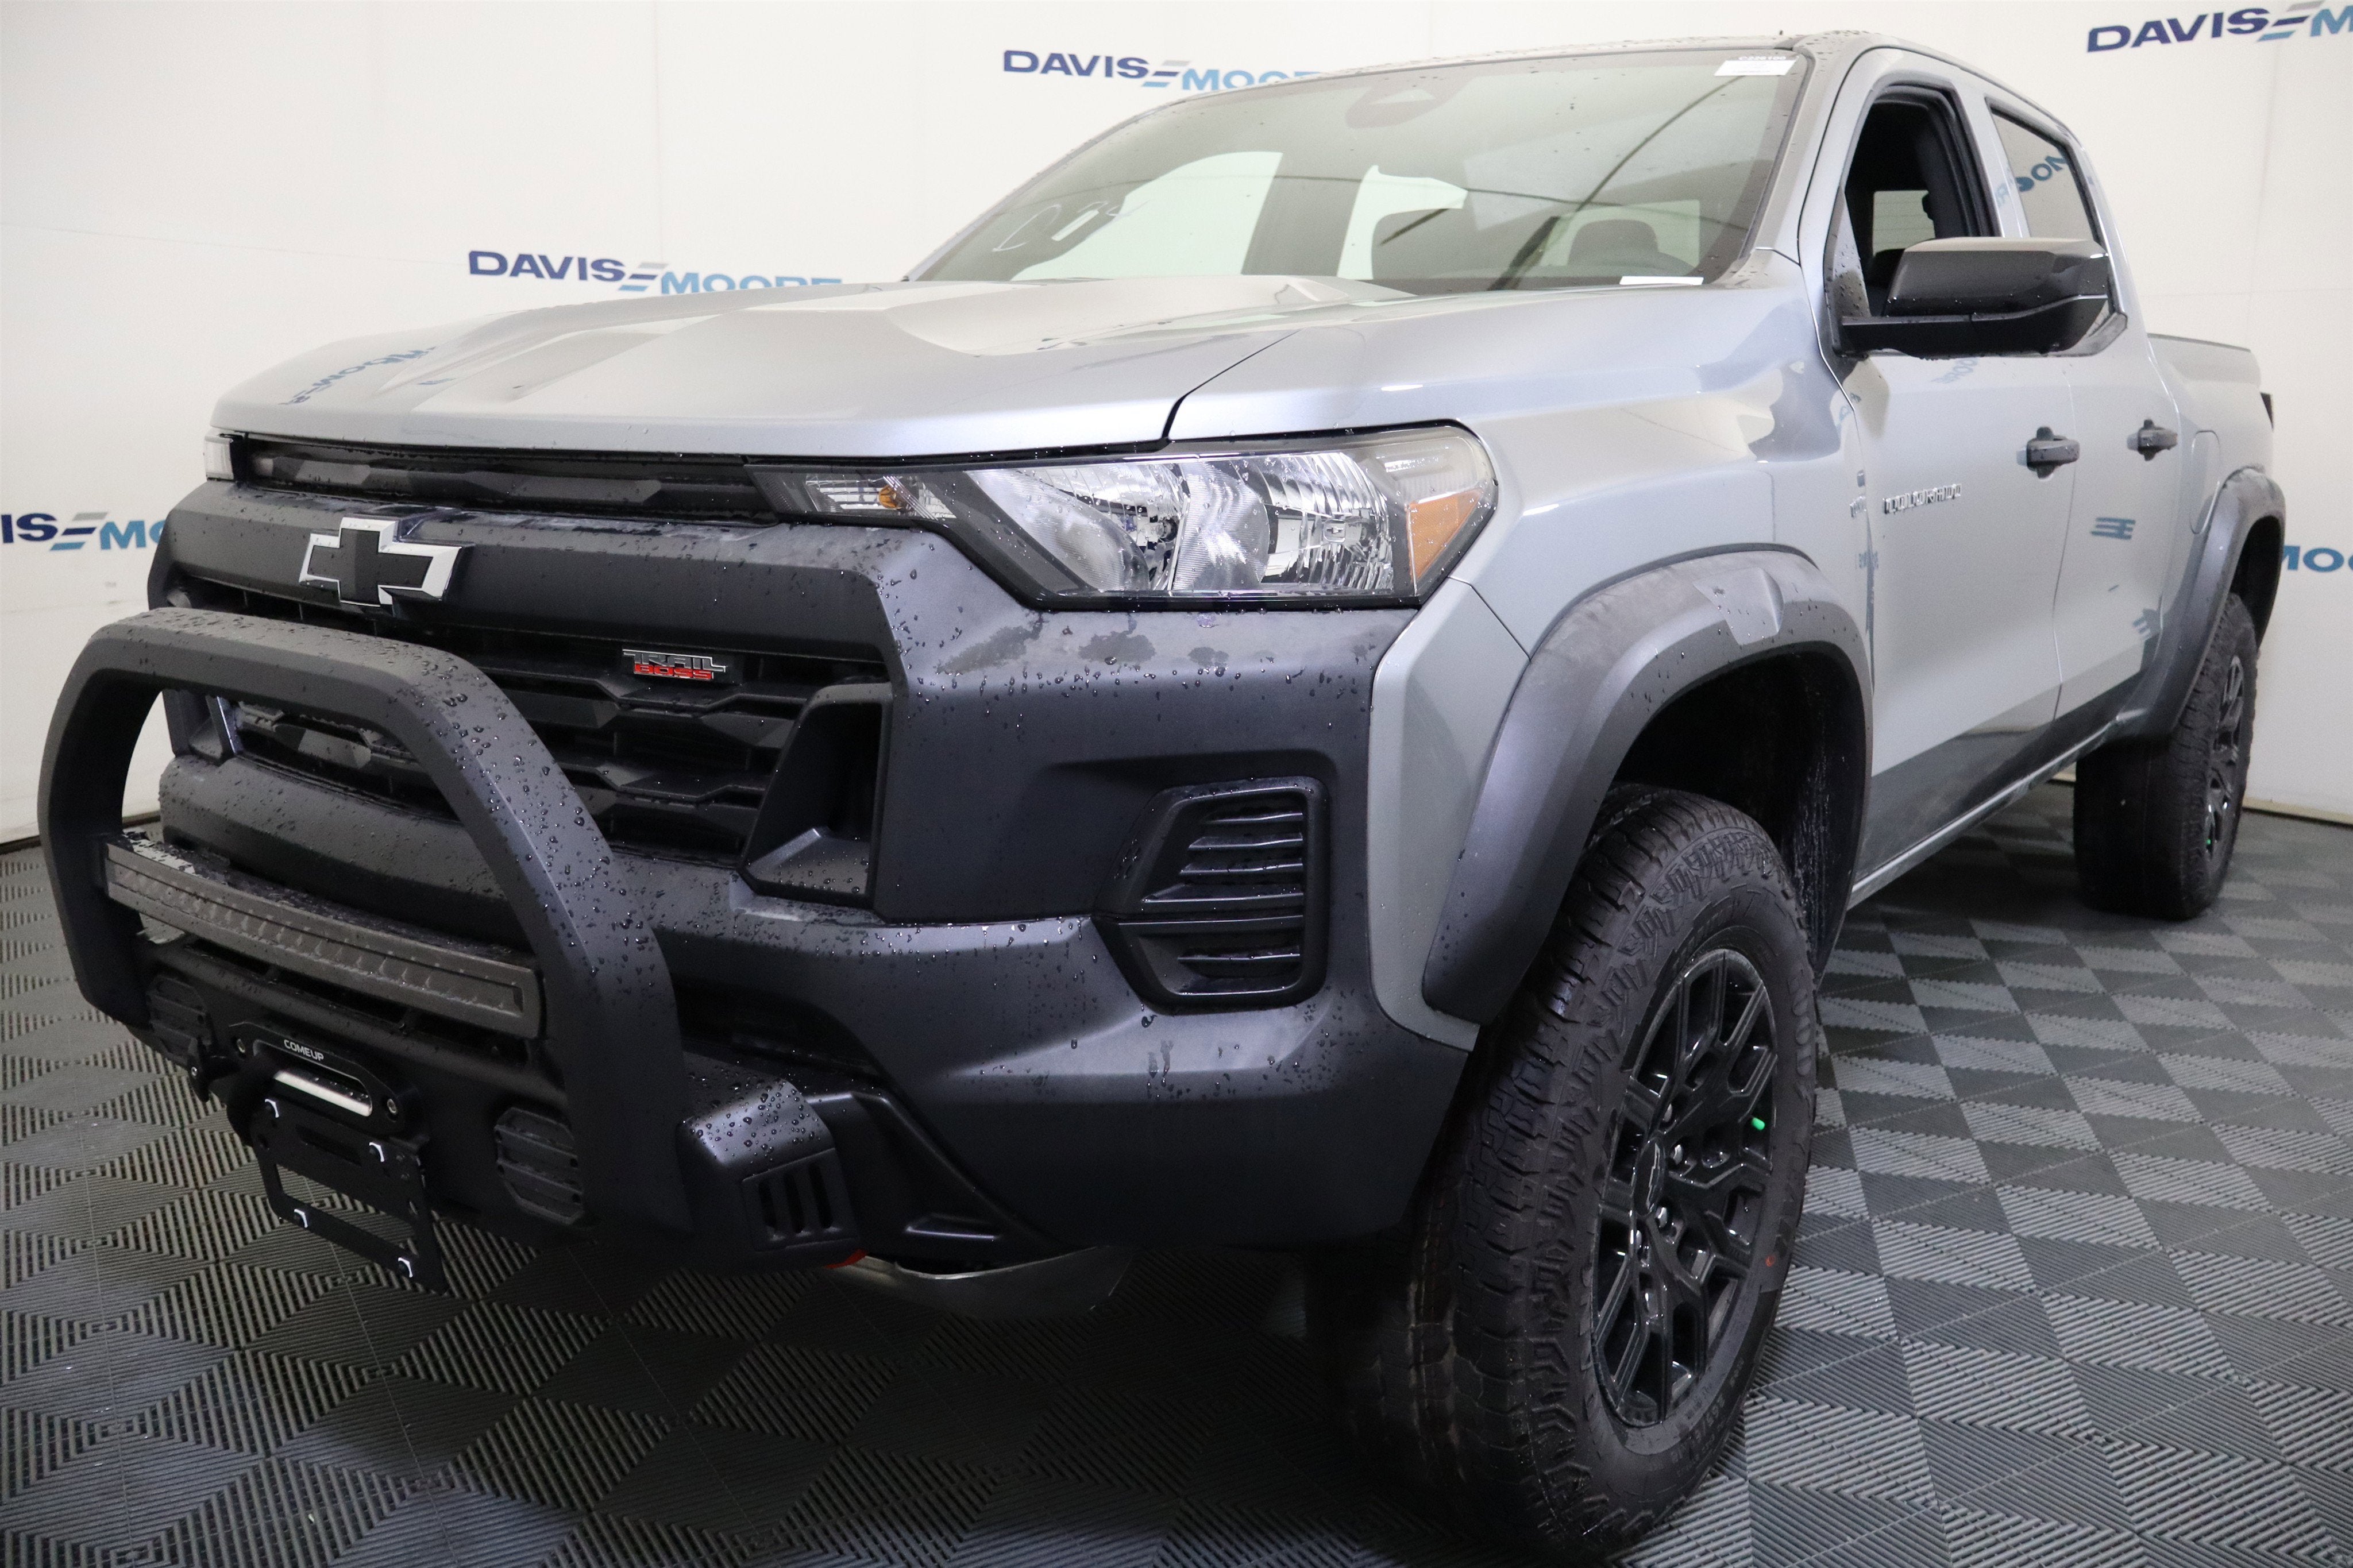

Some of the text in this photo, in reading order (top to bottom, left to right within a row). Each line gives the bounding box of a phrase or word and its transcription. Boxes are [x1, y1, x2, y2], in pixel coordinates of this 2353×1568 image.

[2087, 8, 2271, 53] DAVIS
[1003, 49, 1150, 79] DAVIS
[469, 250, 626, 282] DAVIS
[622, 648, 726, 672] TRAIL
[634, 663, 714, 681] BOSS
[284, 1038, 325, 1062] COMEUP
